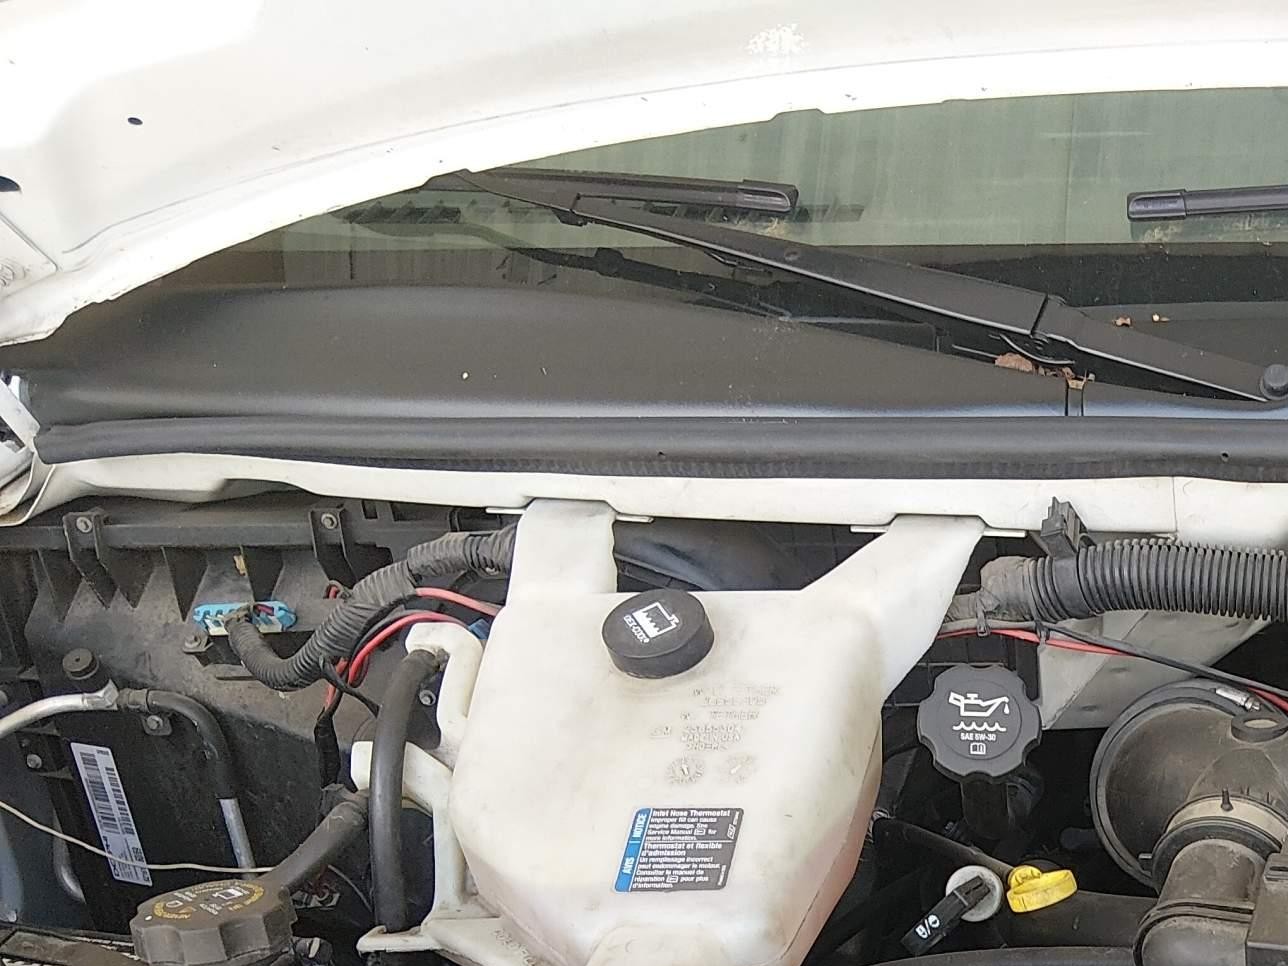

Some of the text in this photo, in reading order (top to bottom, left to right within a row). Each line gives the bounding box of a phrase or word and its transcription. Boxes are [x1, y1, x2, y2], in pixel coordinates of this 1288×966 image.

[960, 732, 996, 741] SAE 5W-30
[632, 813, 647, 838] NOTICE
[622, 857, 635, 875] AVIS
